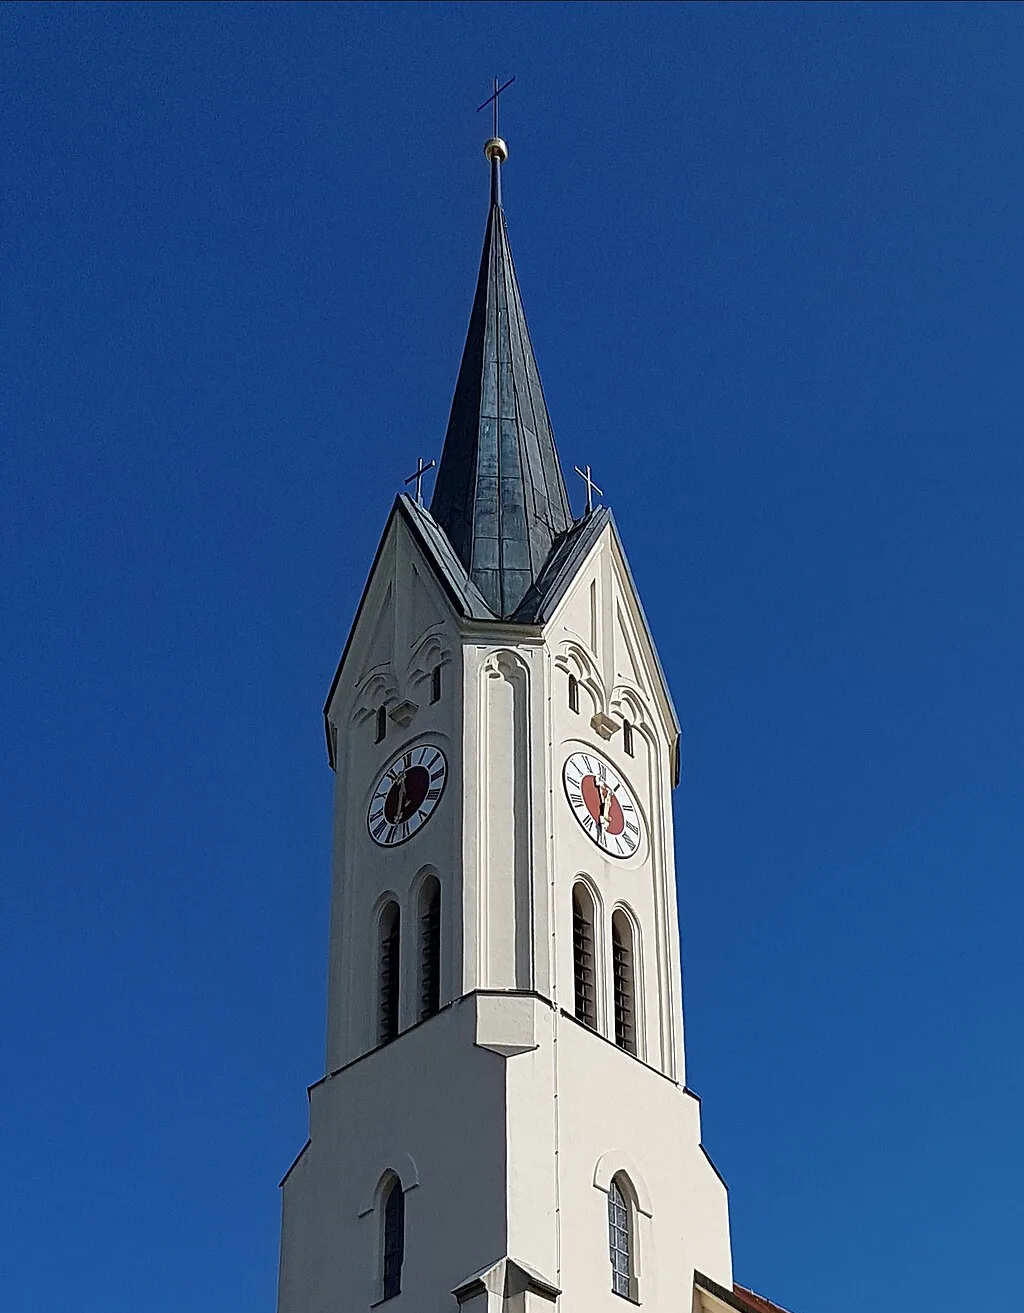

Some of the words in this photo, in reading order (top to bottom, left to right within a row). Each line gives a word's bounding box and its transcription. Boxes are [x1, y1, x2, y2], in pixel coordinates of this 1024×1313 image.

[418, 748, 428, 764] I
[613, 783, 621, 792] I
[374, 791, 388, 799] X
